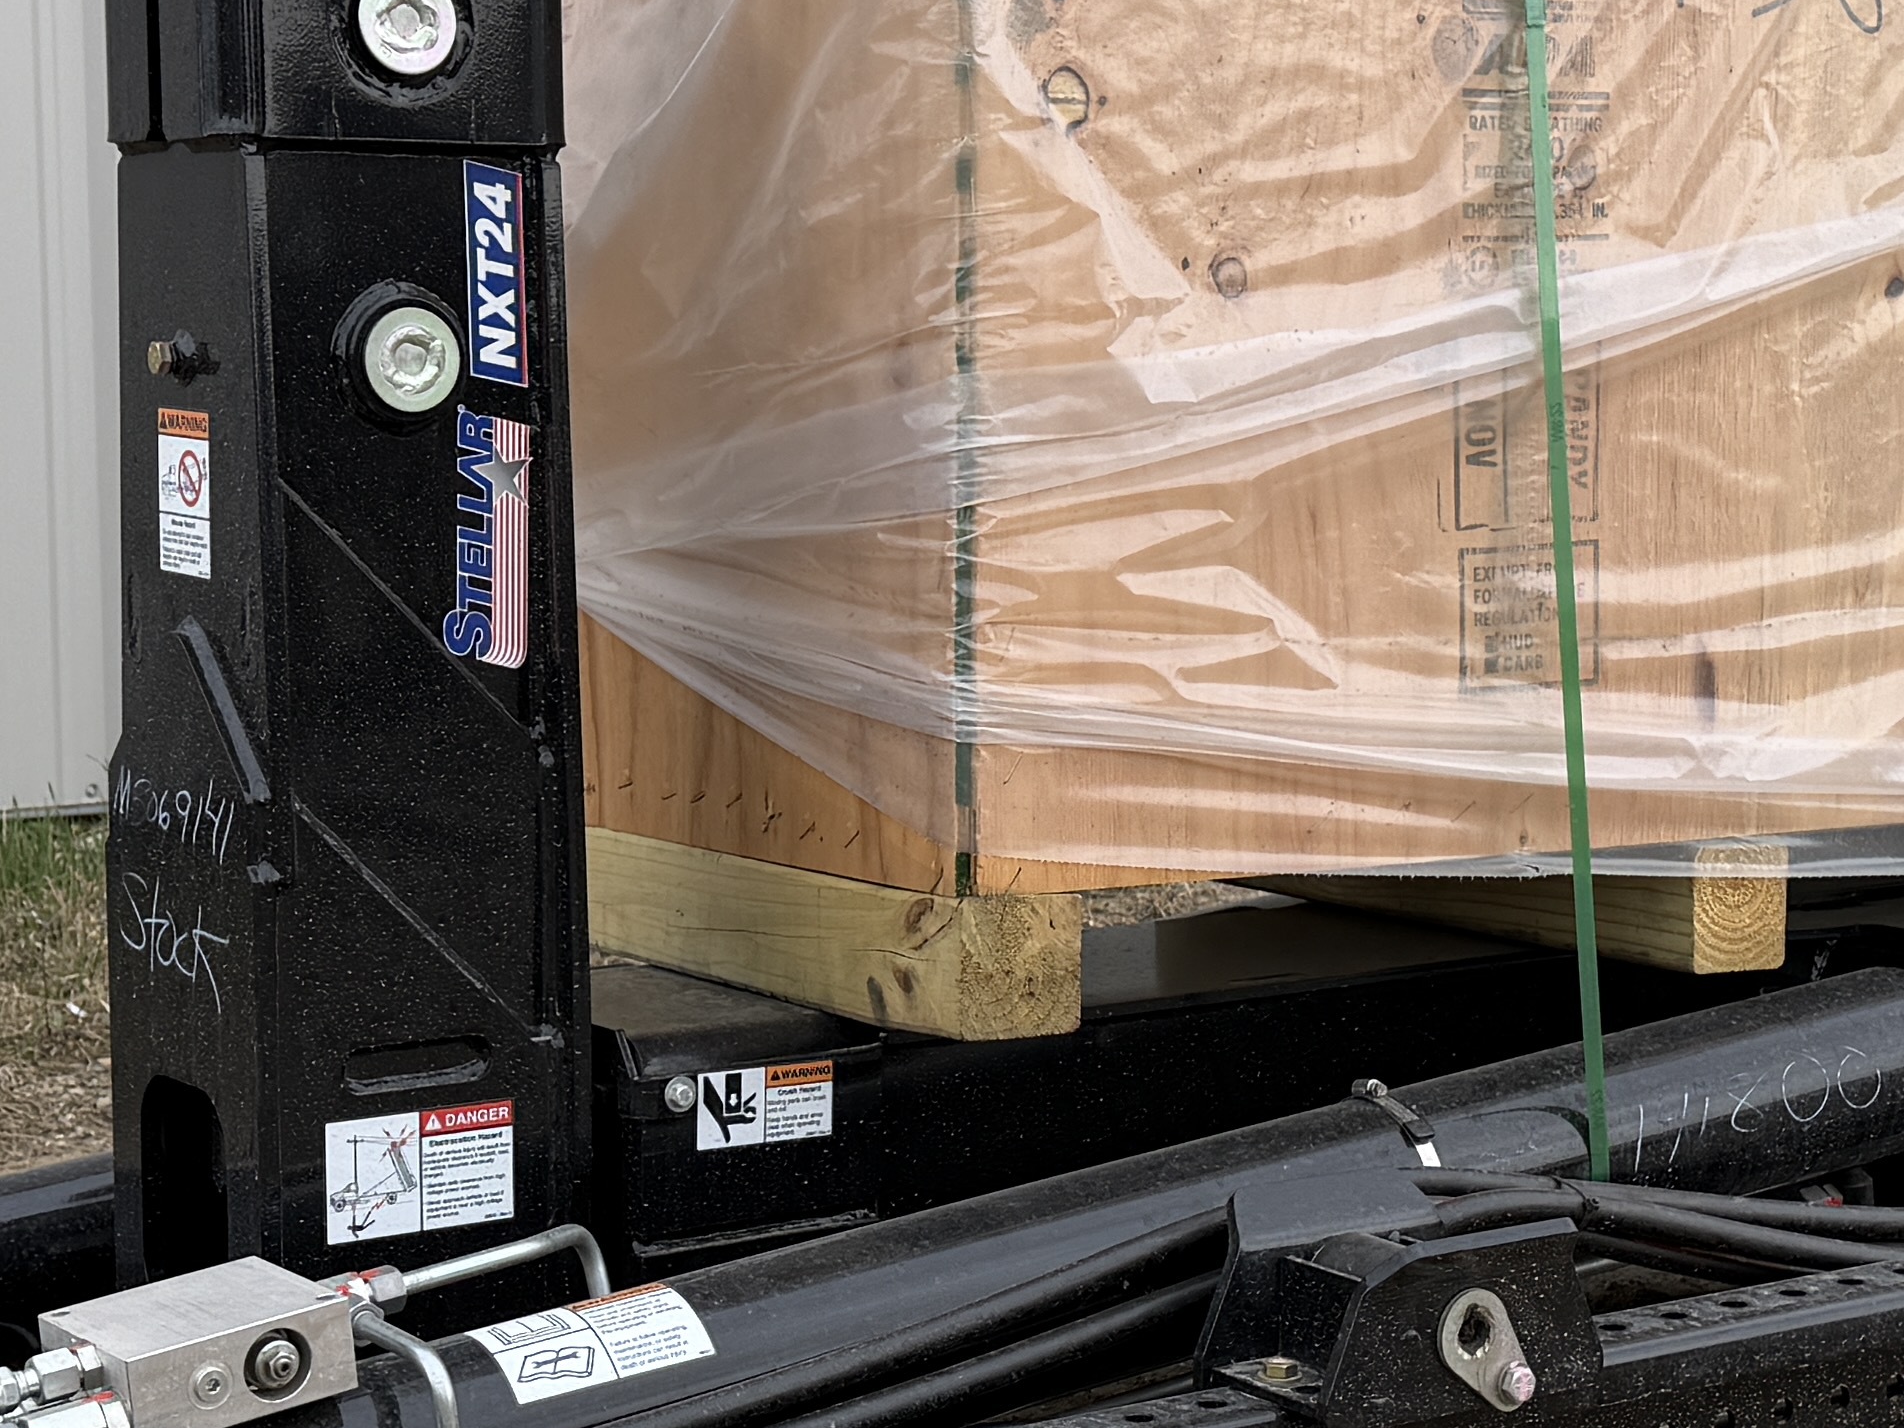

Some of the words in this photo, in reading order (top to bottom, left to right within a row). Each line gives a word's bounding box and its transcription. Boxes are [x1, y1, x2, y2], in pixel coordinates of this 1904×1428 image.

[473, 181, 518, 369] NXT24
[118, 871, 230, 1015] Stock
[781, 1065, 831, 1080] WARNING
[445, 1106, 510, 1127] DANGER
